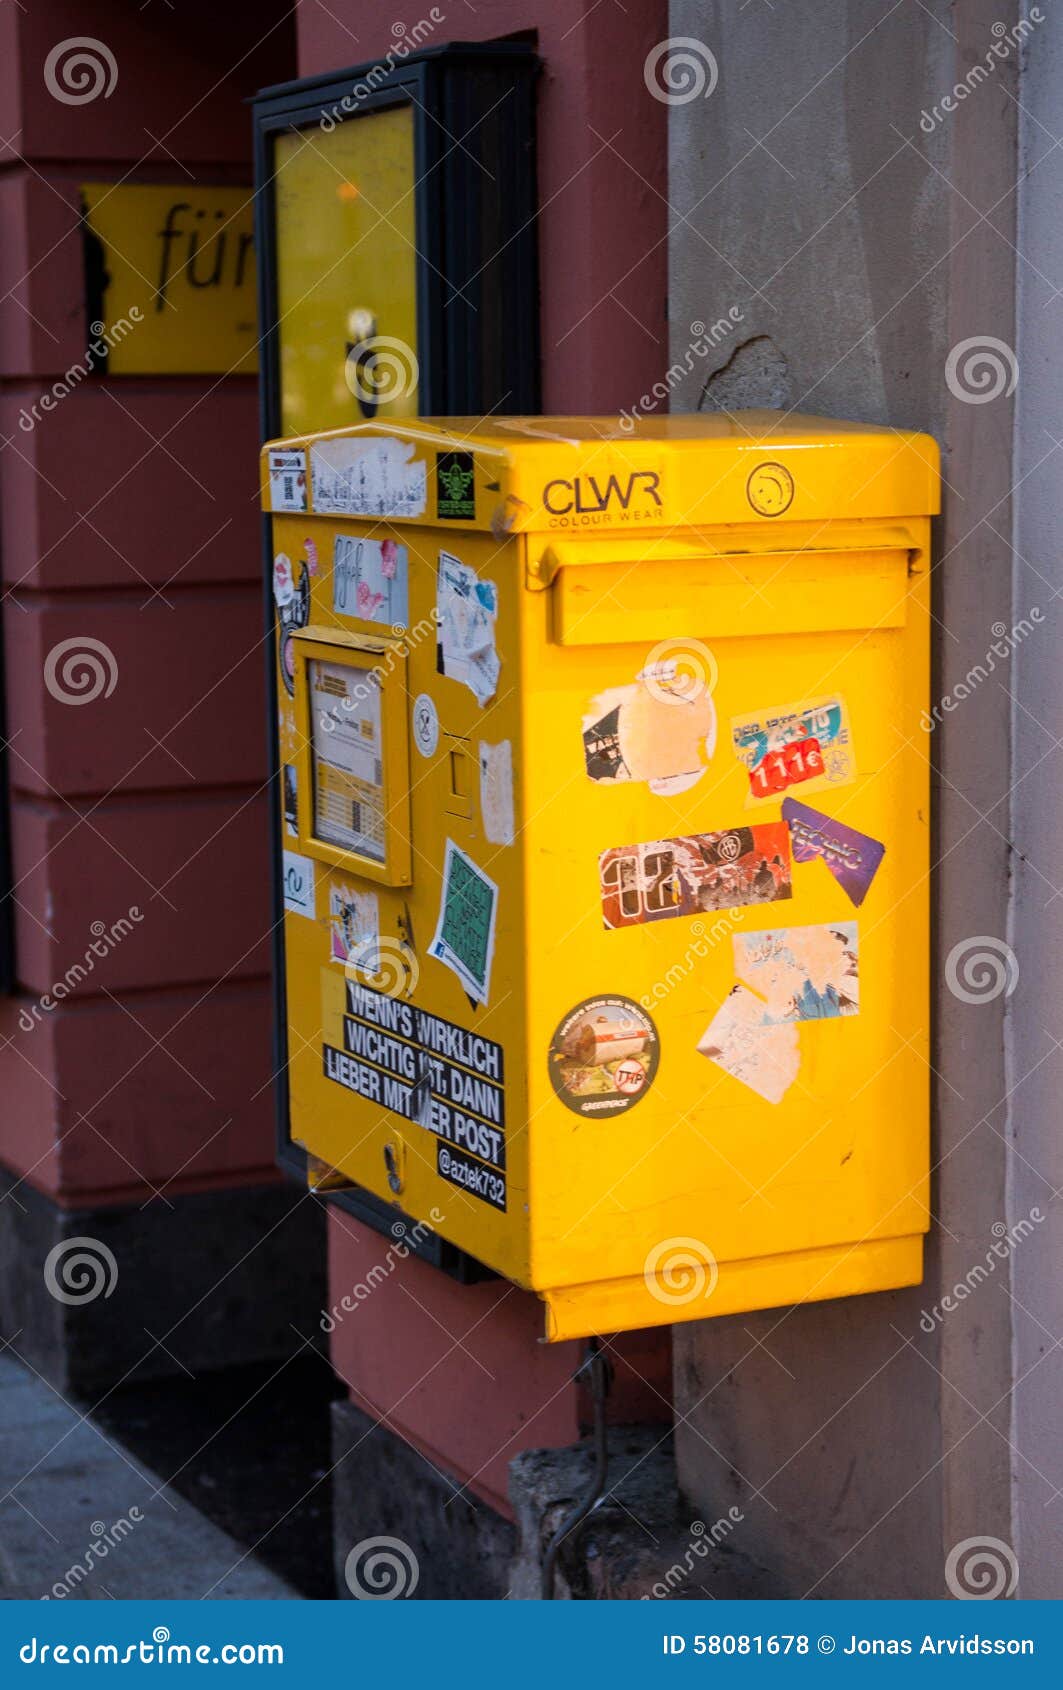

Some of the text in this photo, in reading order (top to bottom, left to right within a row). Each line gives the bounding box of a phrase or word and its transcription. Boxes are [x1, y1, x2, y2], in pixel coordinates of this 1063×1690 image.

[156, 203, 254, 313] für
[543, 472, 662, 515] CLWR
[549, 508, 662, 529] COLOUR WEAR
[346, 1020, 416, 1079] WICHTIG
[450, 1068, 500, 1123] DANN
[348, 981, 412, 1037] WENN'S
[416, 1012, 499, 1079] WIRKLICH
[327, 1048, 381, 1101] LIEBER
[383, 1076, 413, 1118] MIT
[454, 1113, 501, 1165] POST
[439, 1148, 506, 1206] @aztek732
